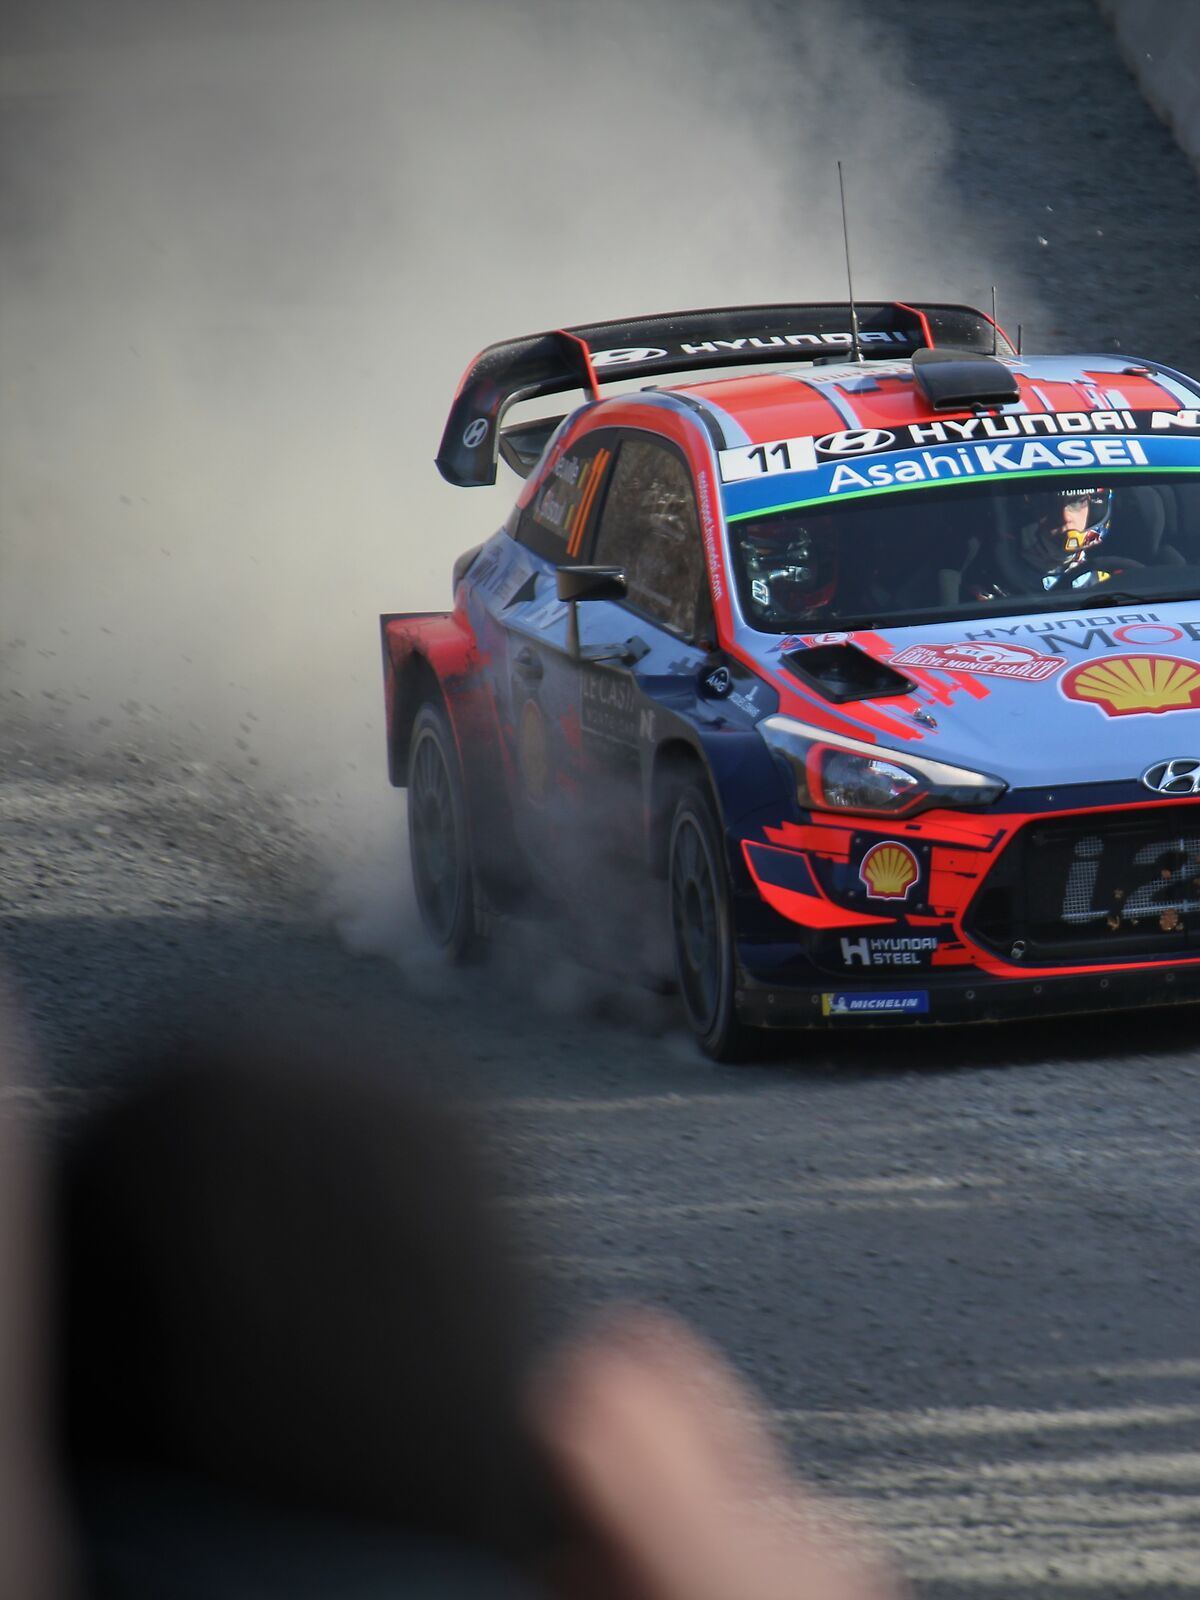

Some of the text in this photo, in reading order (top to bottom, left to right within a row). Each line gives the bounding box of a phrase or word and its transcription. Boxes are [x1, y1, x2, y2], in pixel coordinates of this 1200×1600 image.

[680, 331, 908, 354] HYUNDAI
[907, 411, 1137, 444] HYUNDAI
[747, 442, 791, 473] 11
[965, 612, 1161, 641] HYUNDAI
[895, 650, 1056, 678] RALLYE MONTE-CARLO
[871, 937, 937, 950] HYUNDAI
[873, 952, 921, 965] STEEL
[850, 998, 918, 1009] MICHELIN
